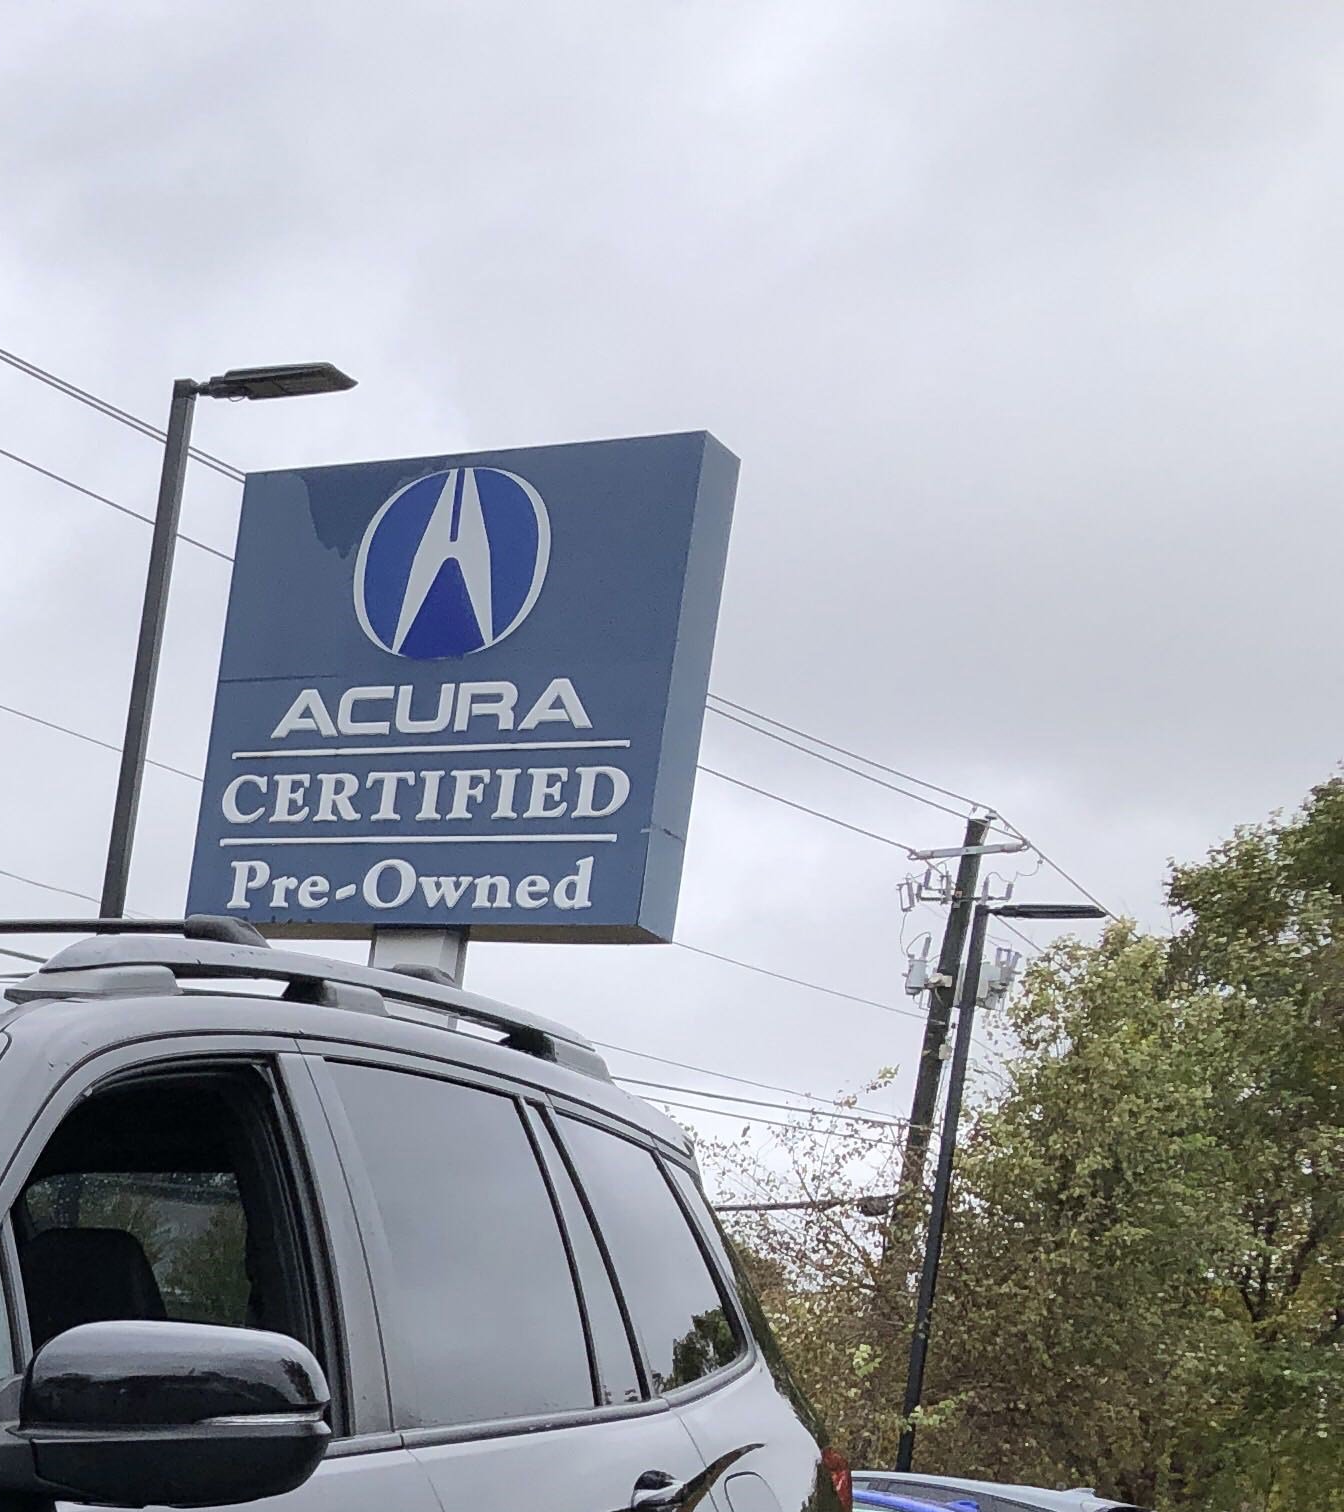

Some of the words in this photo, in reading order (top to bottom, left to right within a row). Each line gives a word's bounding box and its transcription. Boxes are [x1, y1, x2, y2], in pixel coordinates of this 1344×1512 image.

[271, 678, 593, 738] ACURA
[221, 765, 631, 824] CERTIFIED
[226, 856, 594, 910] Pre-Owned
